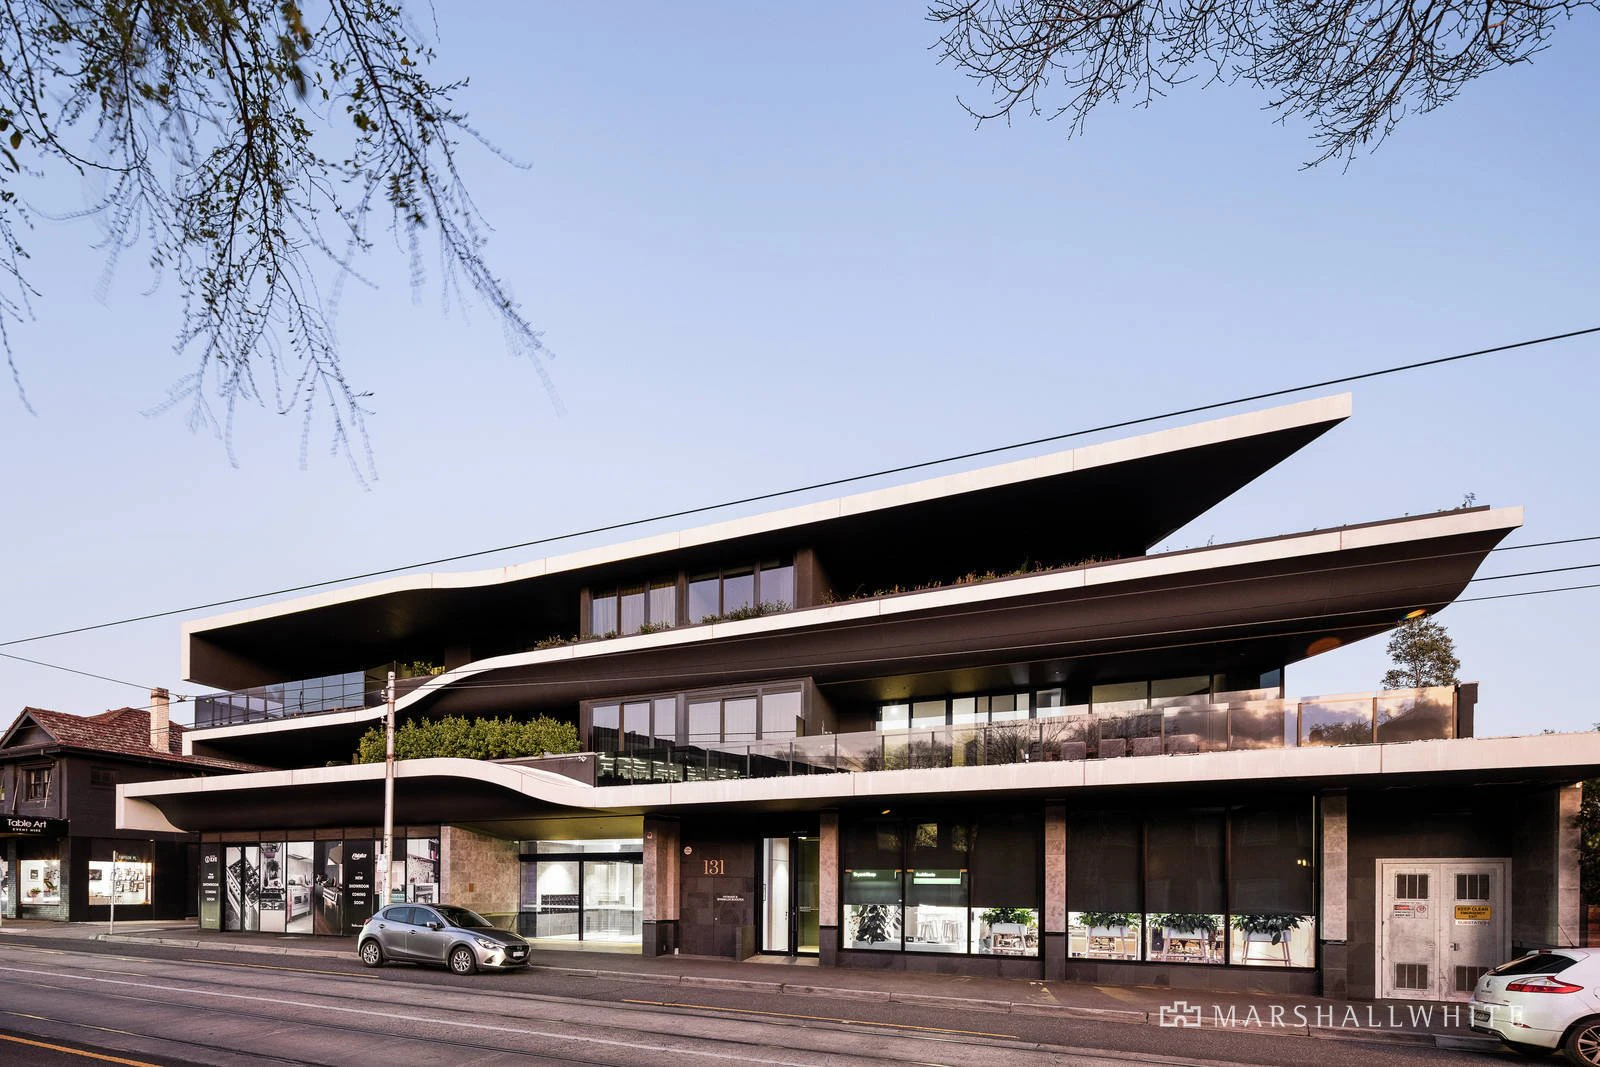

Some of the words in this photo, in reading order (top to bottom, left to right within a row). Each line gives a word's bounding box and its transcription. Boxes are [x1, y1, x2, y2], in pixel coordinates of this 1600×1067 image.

[7, 818, 32, 828] Table
[33, 820, 47, 828] Art
[703, 859, 725, 875] 131
